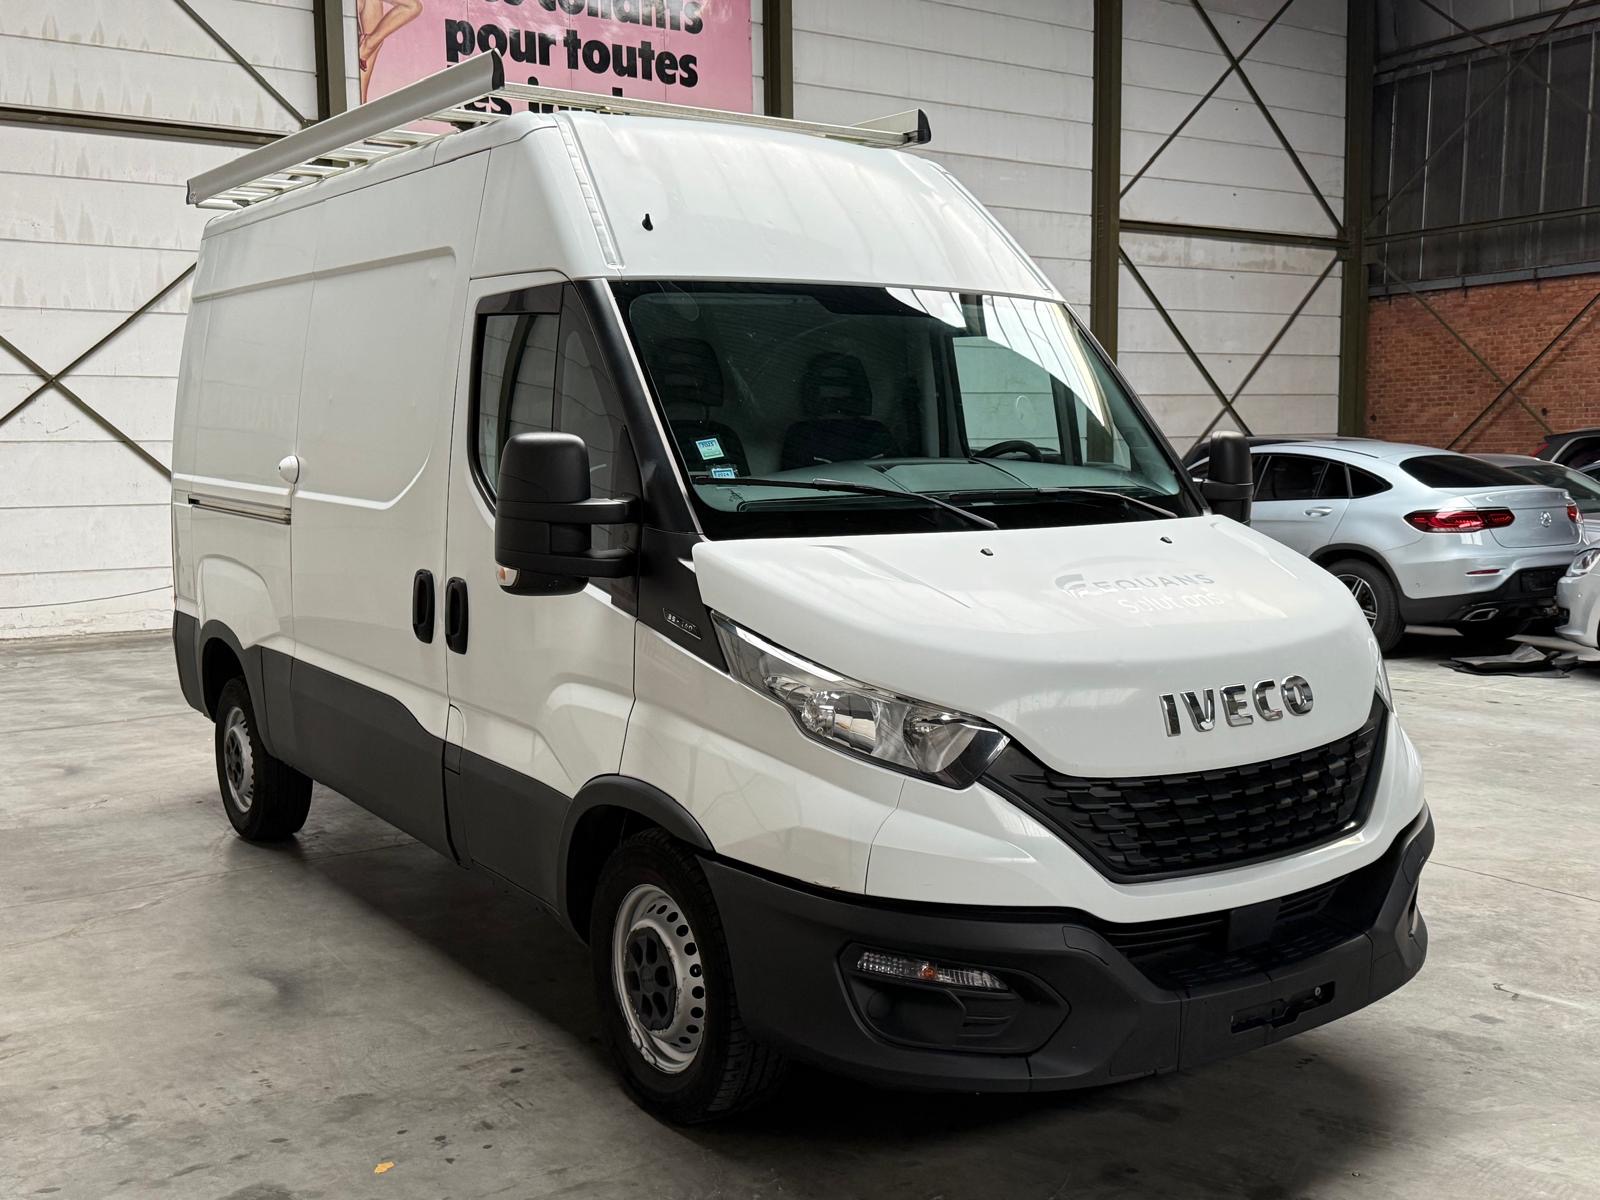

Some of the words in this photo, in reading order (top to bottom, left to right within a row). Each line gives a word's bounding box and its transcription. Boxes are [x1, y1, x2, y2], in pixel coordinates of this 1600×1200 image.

[444, 18, 556, 66] pour
[563, 28, 699, 88] toutes
[1091, 574, 1216, 591] EQUANS
[1158, 674, 1314, 737] IVECO
